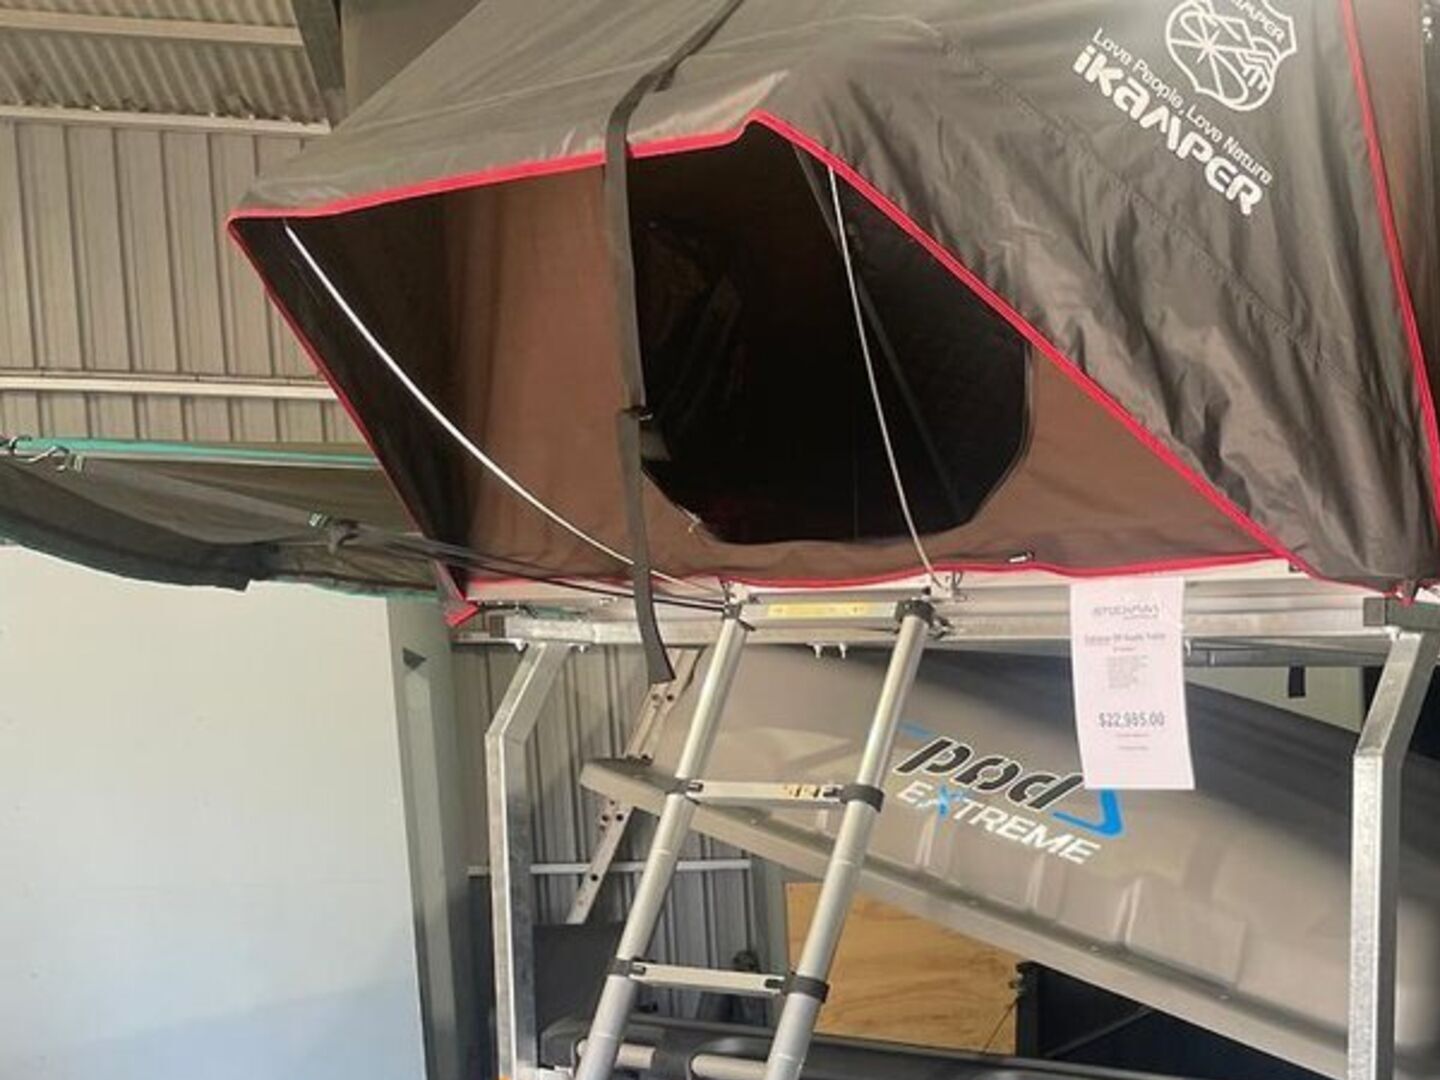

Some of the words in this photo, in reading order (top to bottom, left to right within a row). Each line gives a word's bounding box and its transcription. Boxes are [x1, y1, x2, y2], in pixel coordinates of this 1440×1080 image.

[1092, 27, 1131, 67] Love
[1133, 60, 1184, 115] People,
[1186, 104, 1223, 143] Love
[1223, 135, 1273, 186] Nature
[897, 780, 1101, 864] EXTREME
